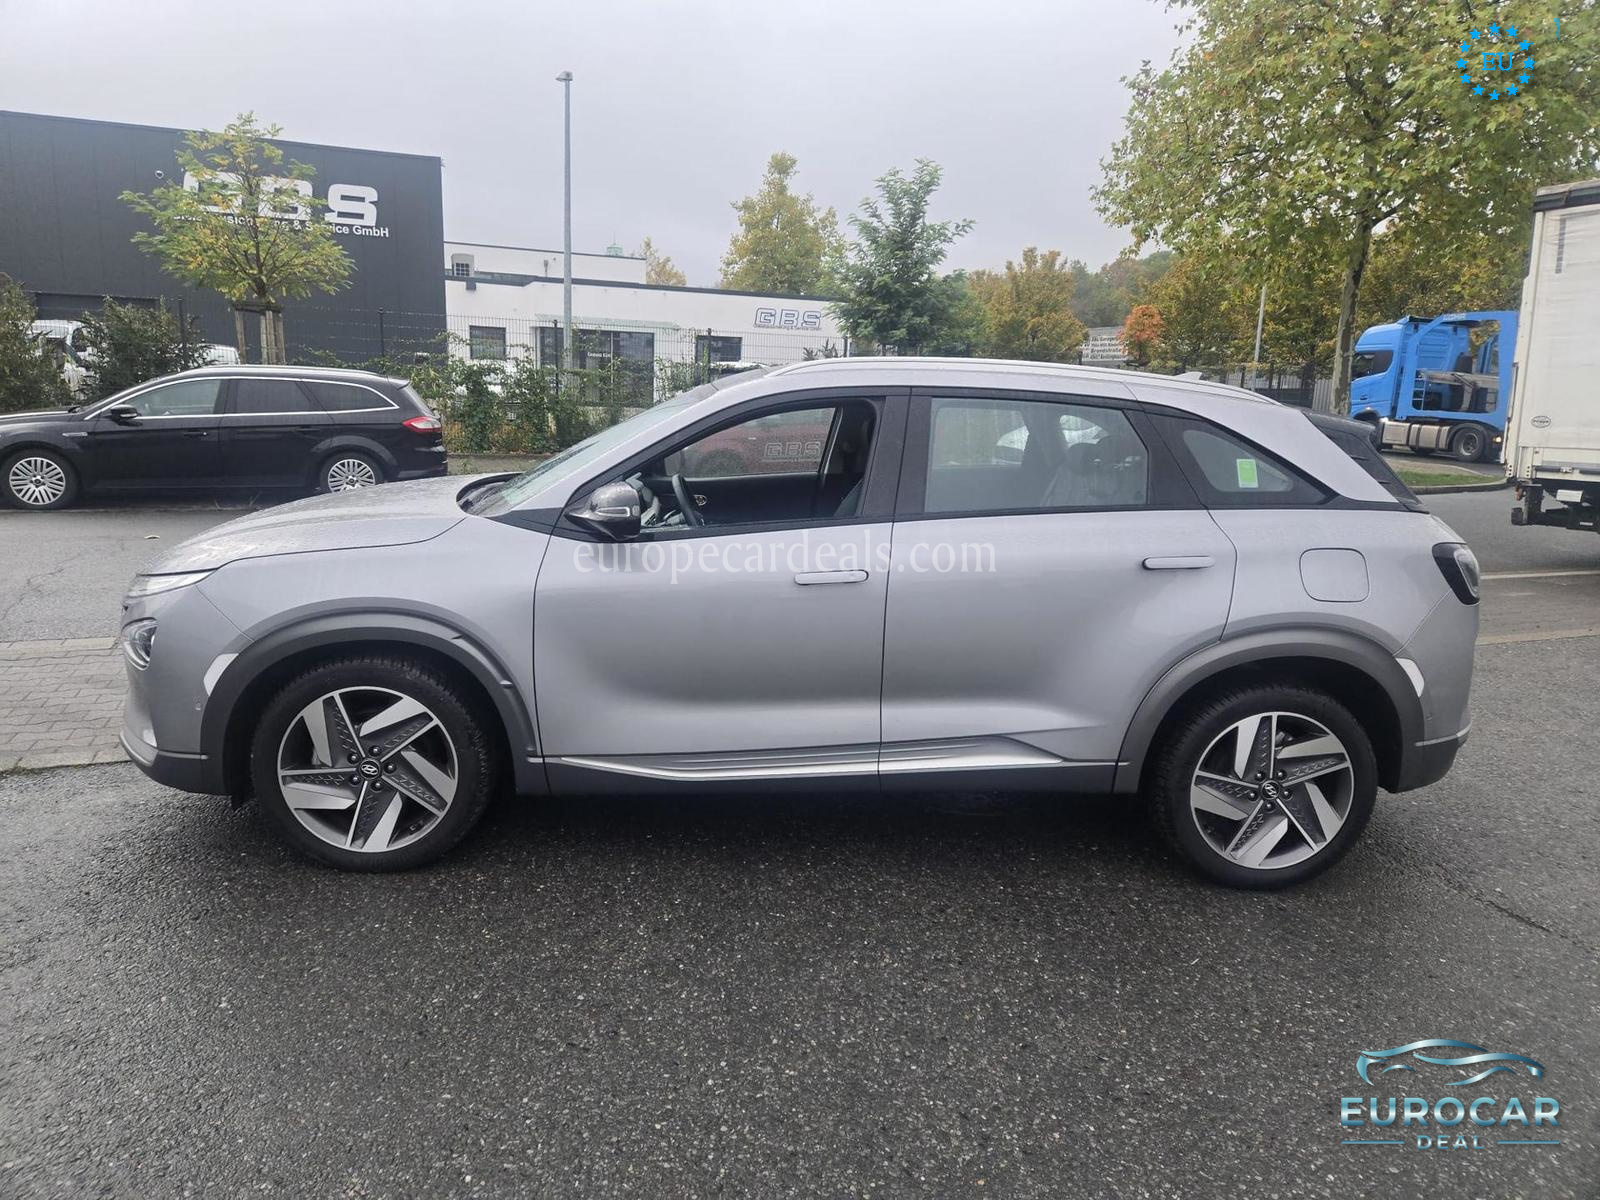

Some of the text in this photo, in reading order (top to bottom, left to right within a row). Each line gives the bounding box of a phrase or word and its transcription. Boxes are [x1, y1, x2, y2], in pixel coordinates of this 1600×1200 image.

[305, 220, 350, 235] Sice
[352, 224, 389, 237] GmbH
[755, 307, 821, 328] GBS
